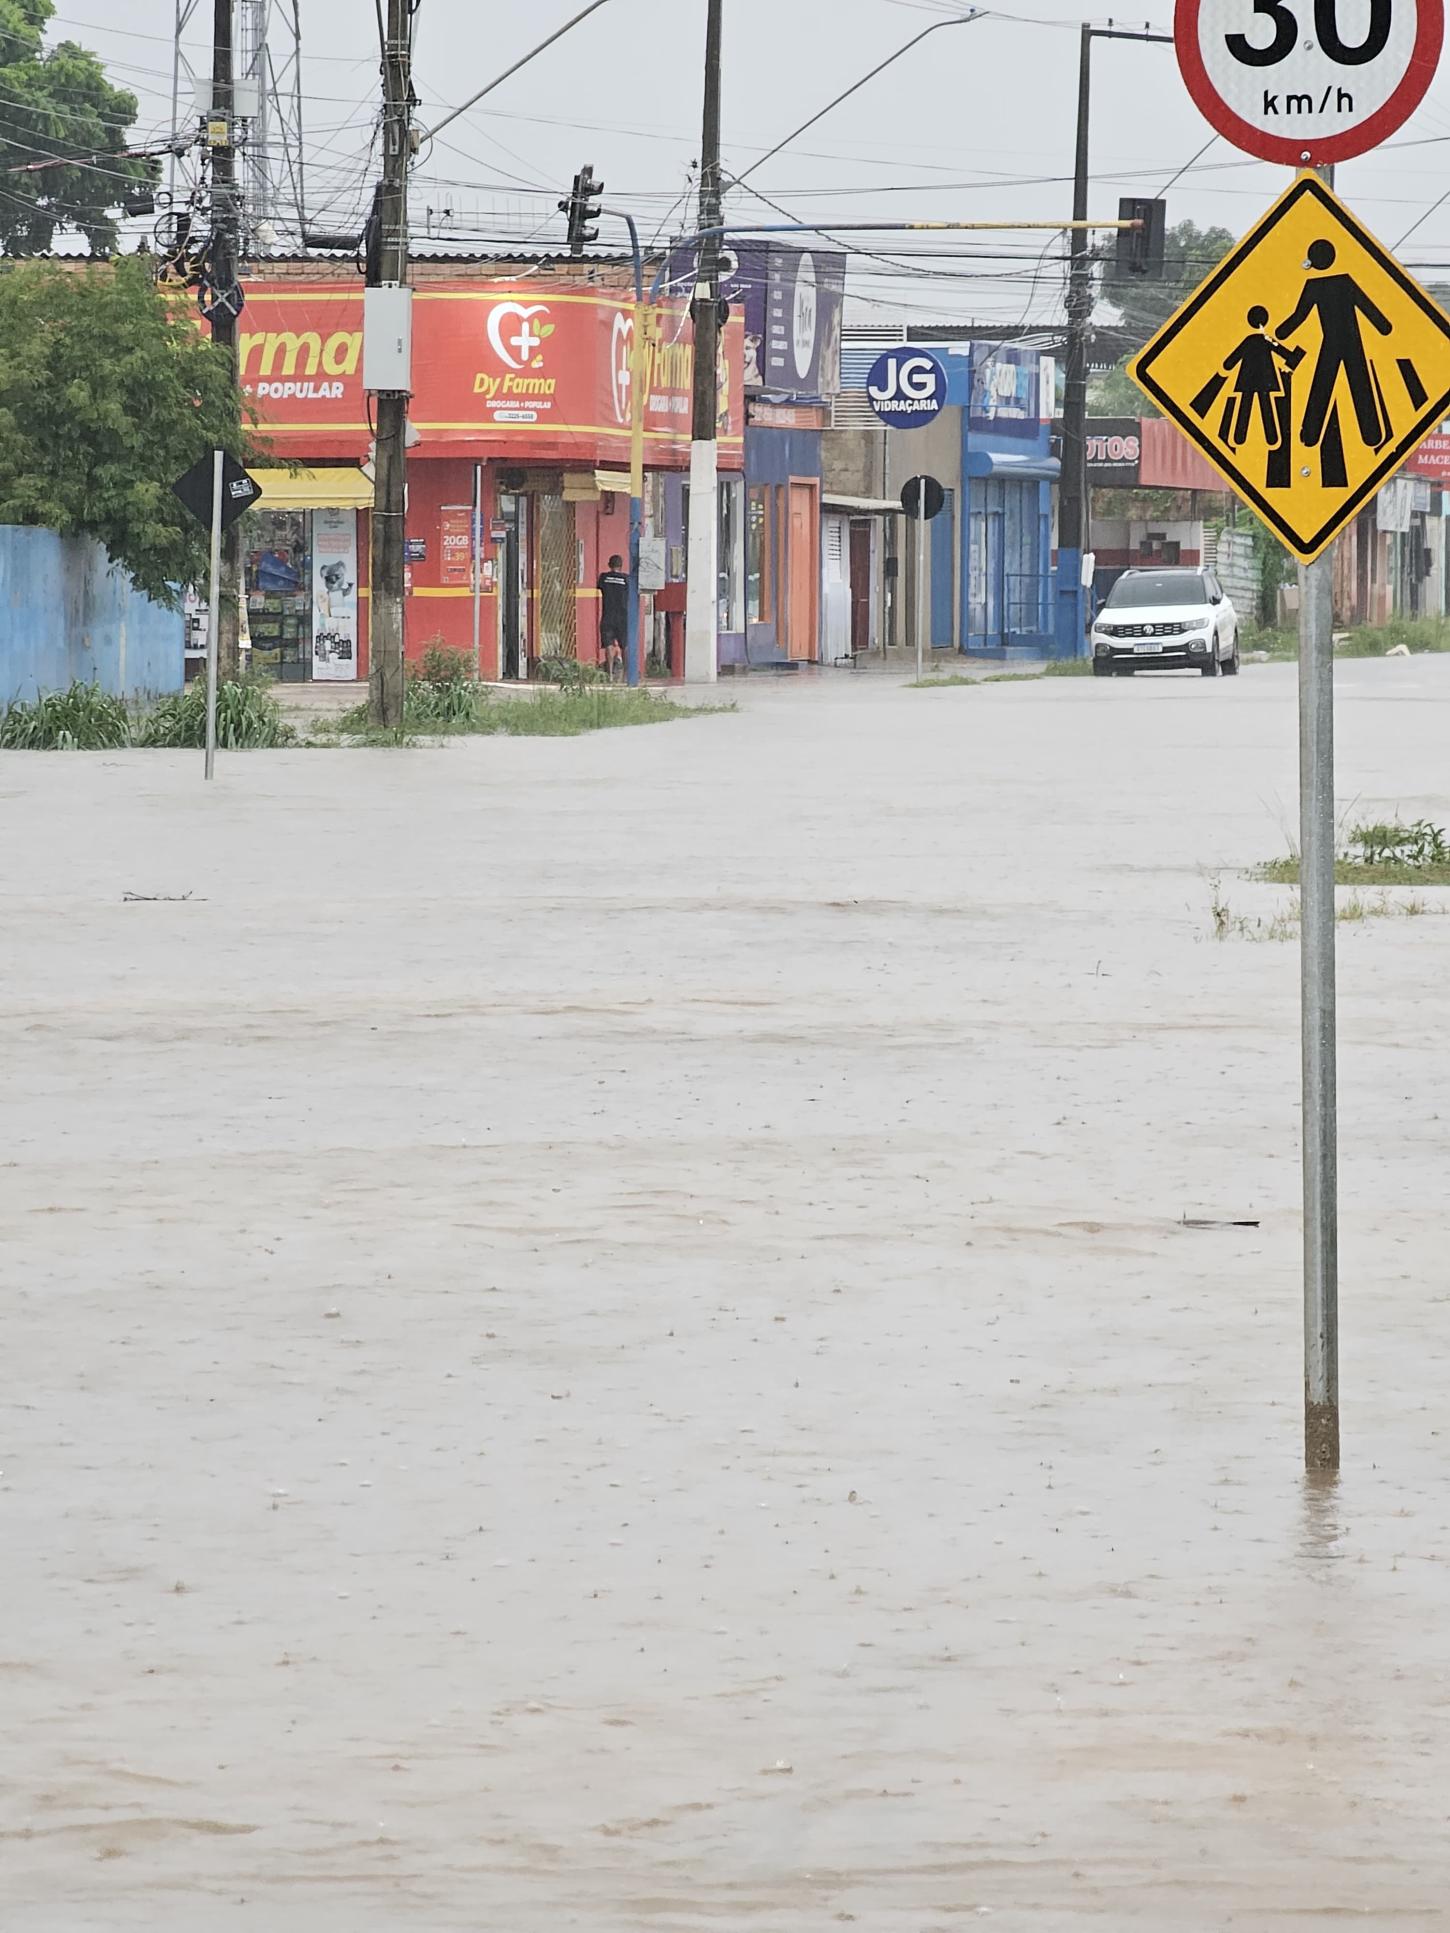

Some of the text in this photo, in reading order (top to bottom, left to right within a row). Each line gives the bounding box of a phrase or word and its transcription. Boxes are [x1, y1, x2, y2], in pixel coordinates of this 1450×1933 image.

[1224, 0, 1392, 67] 30
[1263, 86, 1353, 115] km/h
[240, 332, 363, 376] rma
[257, 382, 344, 398] POPULAR
[473, 373, 556, 399] Dy Farma
[868, 357, 936, 400] JG
[872, 399, 939, 413] VIDRAÇARIA
[1086, 436, 1139, 460] OTOS
[1419, 439, 1450, 450] ARBE
[1418, 455, 1450, 465] MACE
[443, 535, 469, 546] 20GB
